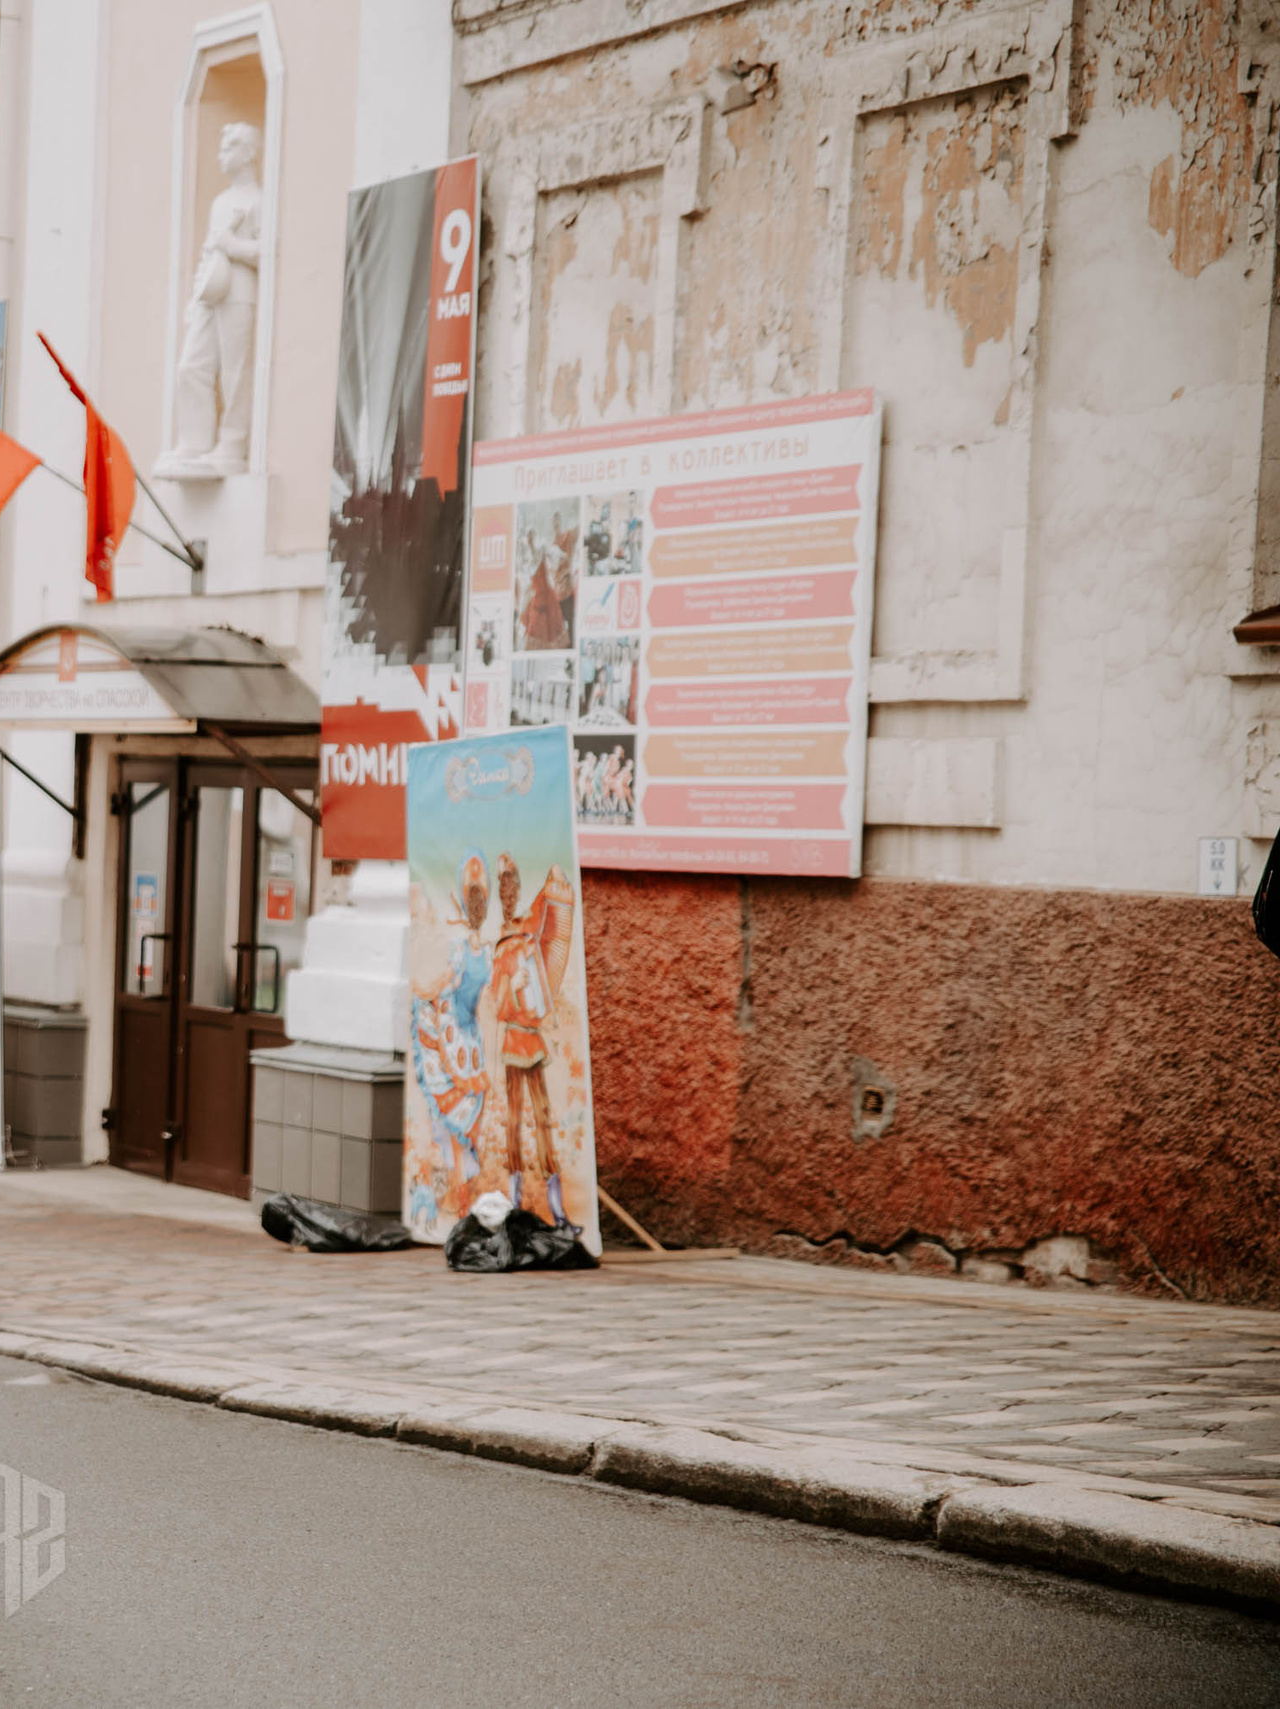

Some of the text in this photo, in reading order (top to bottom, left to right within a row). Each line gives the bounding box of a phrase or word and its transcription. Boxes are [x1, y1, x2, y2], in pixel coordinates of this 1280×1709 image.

[441, 208, 471, 293] 9
[437, 291, 470, 320] МАЯ
[515, 435, 810, 493] Приглашает в коллективы
